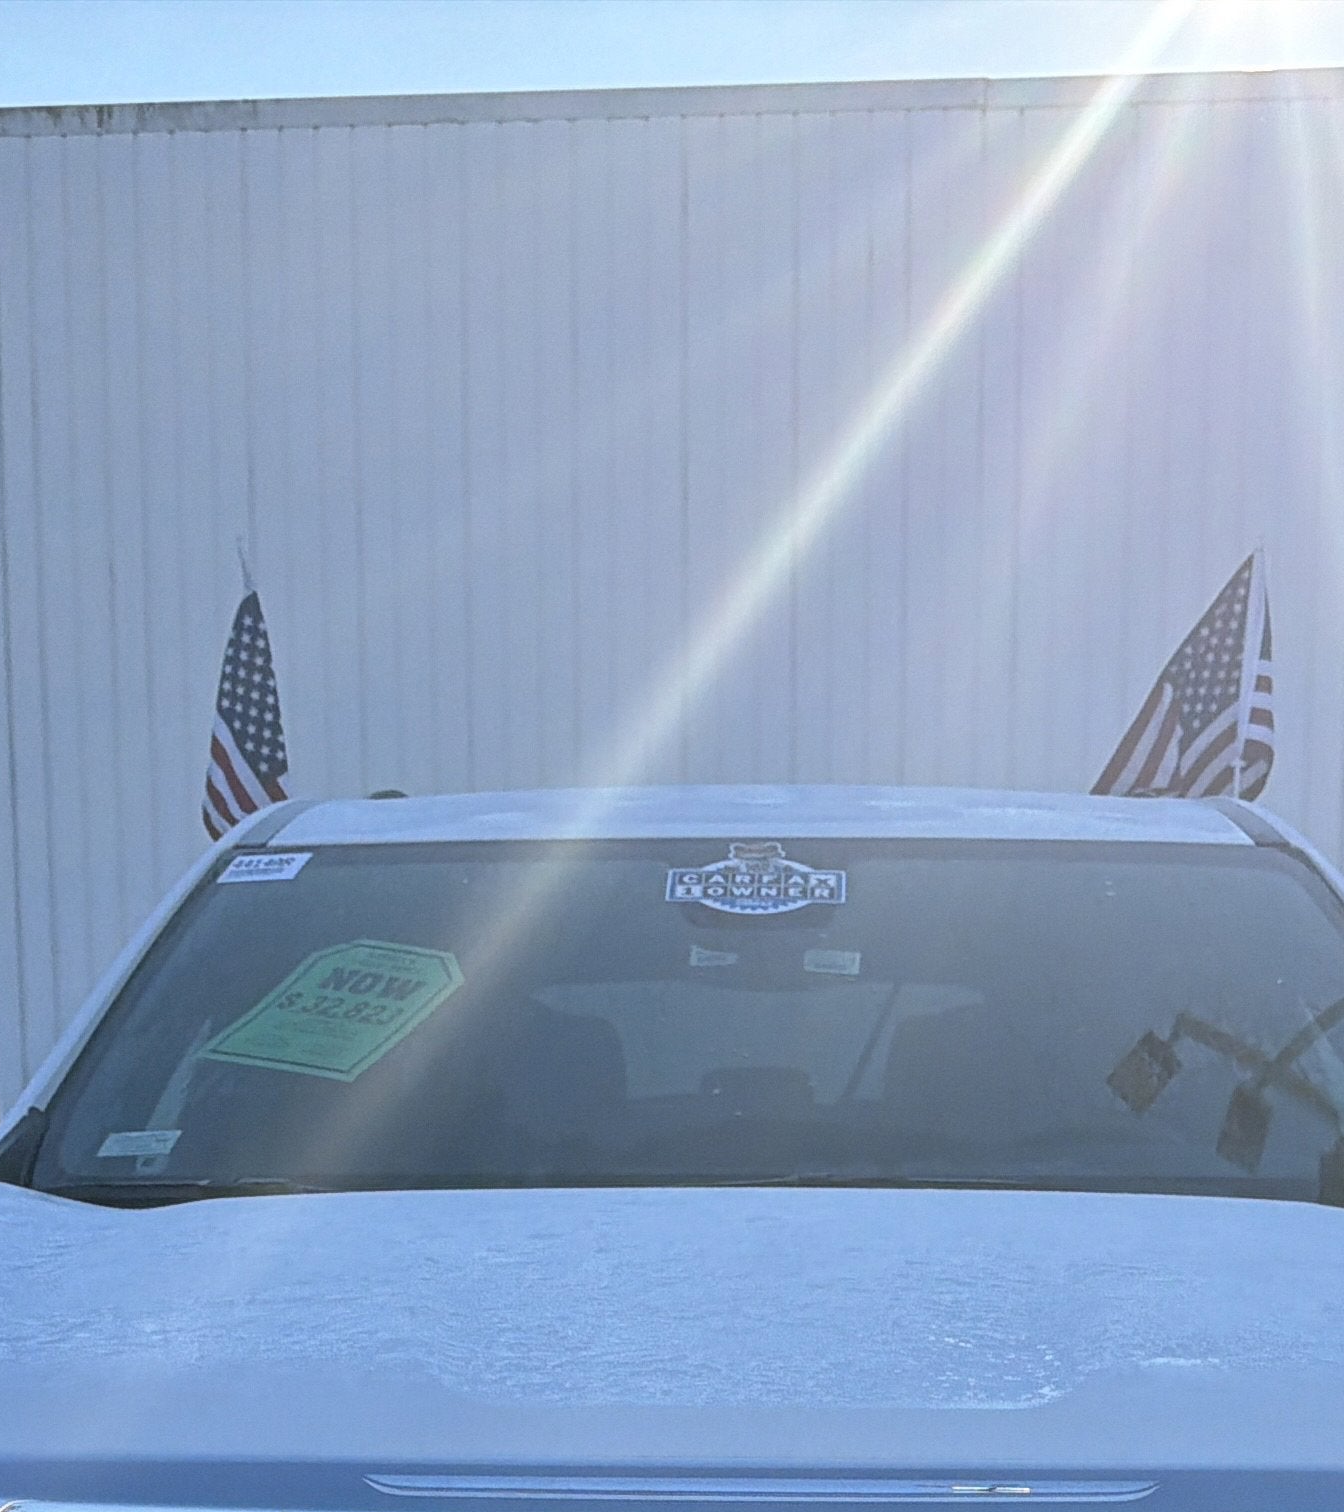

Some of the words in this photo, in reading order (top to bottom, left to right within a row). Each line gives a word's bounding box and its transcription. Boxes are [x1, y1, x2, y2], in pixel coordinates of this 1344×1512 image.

[682, 873, 836, 886] CARFAX
[707, 887, 830, 898] OWNER
[318, 966, 426, 1001] NOW
